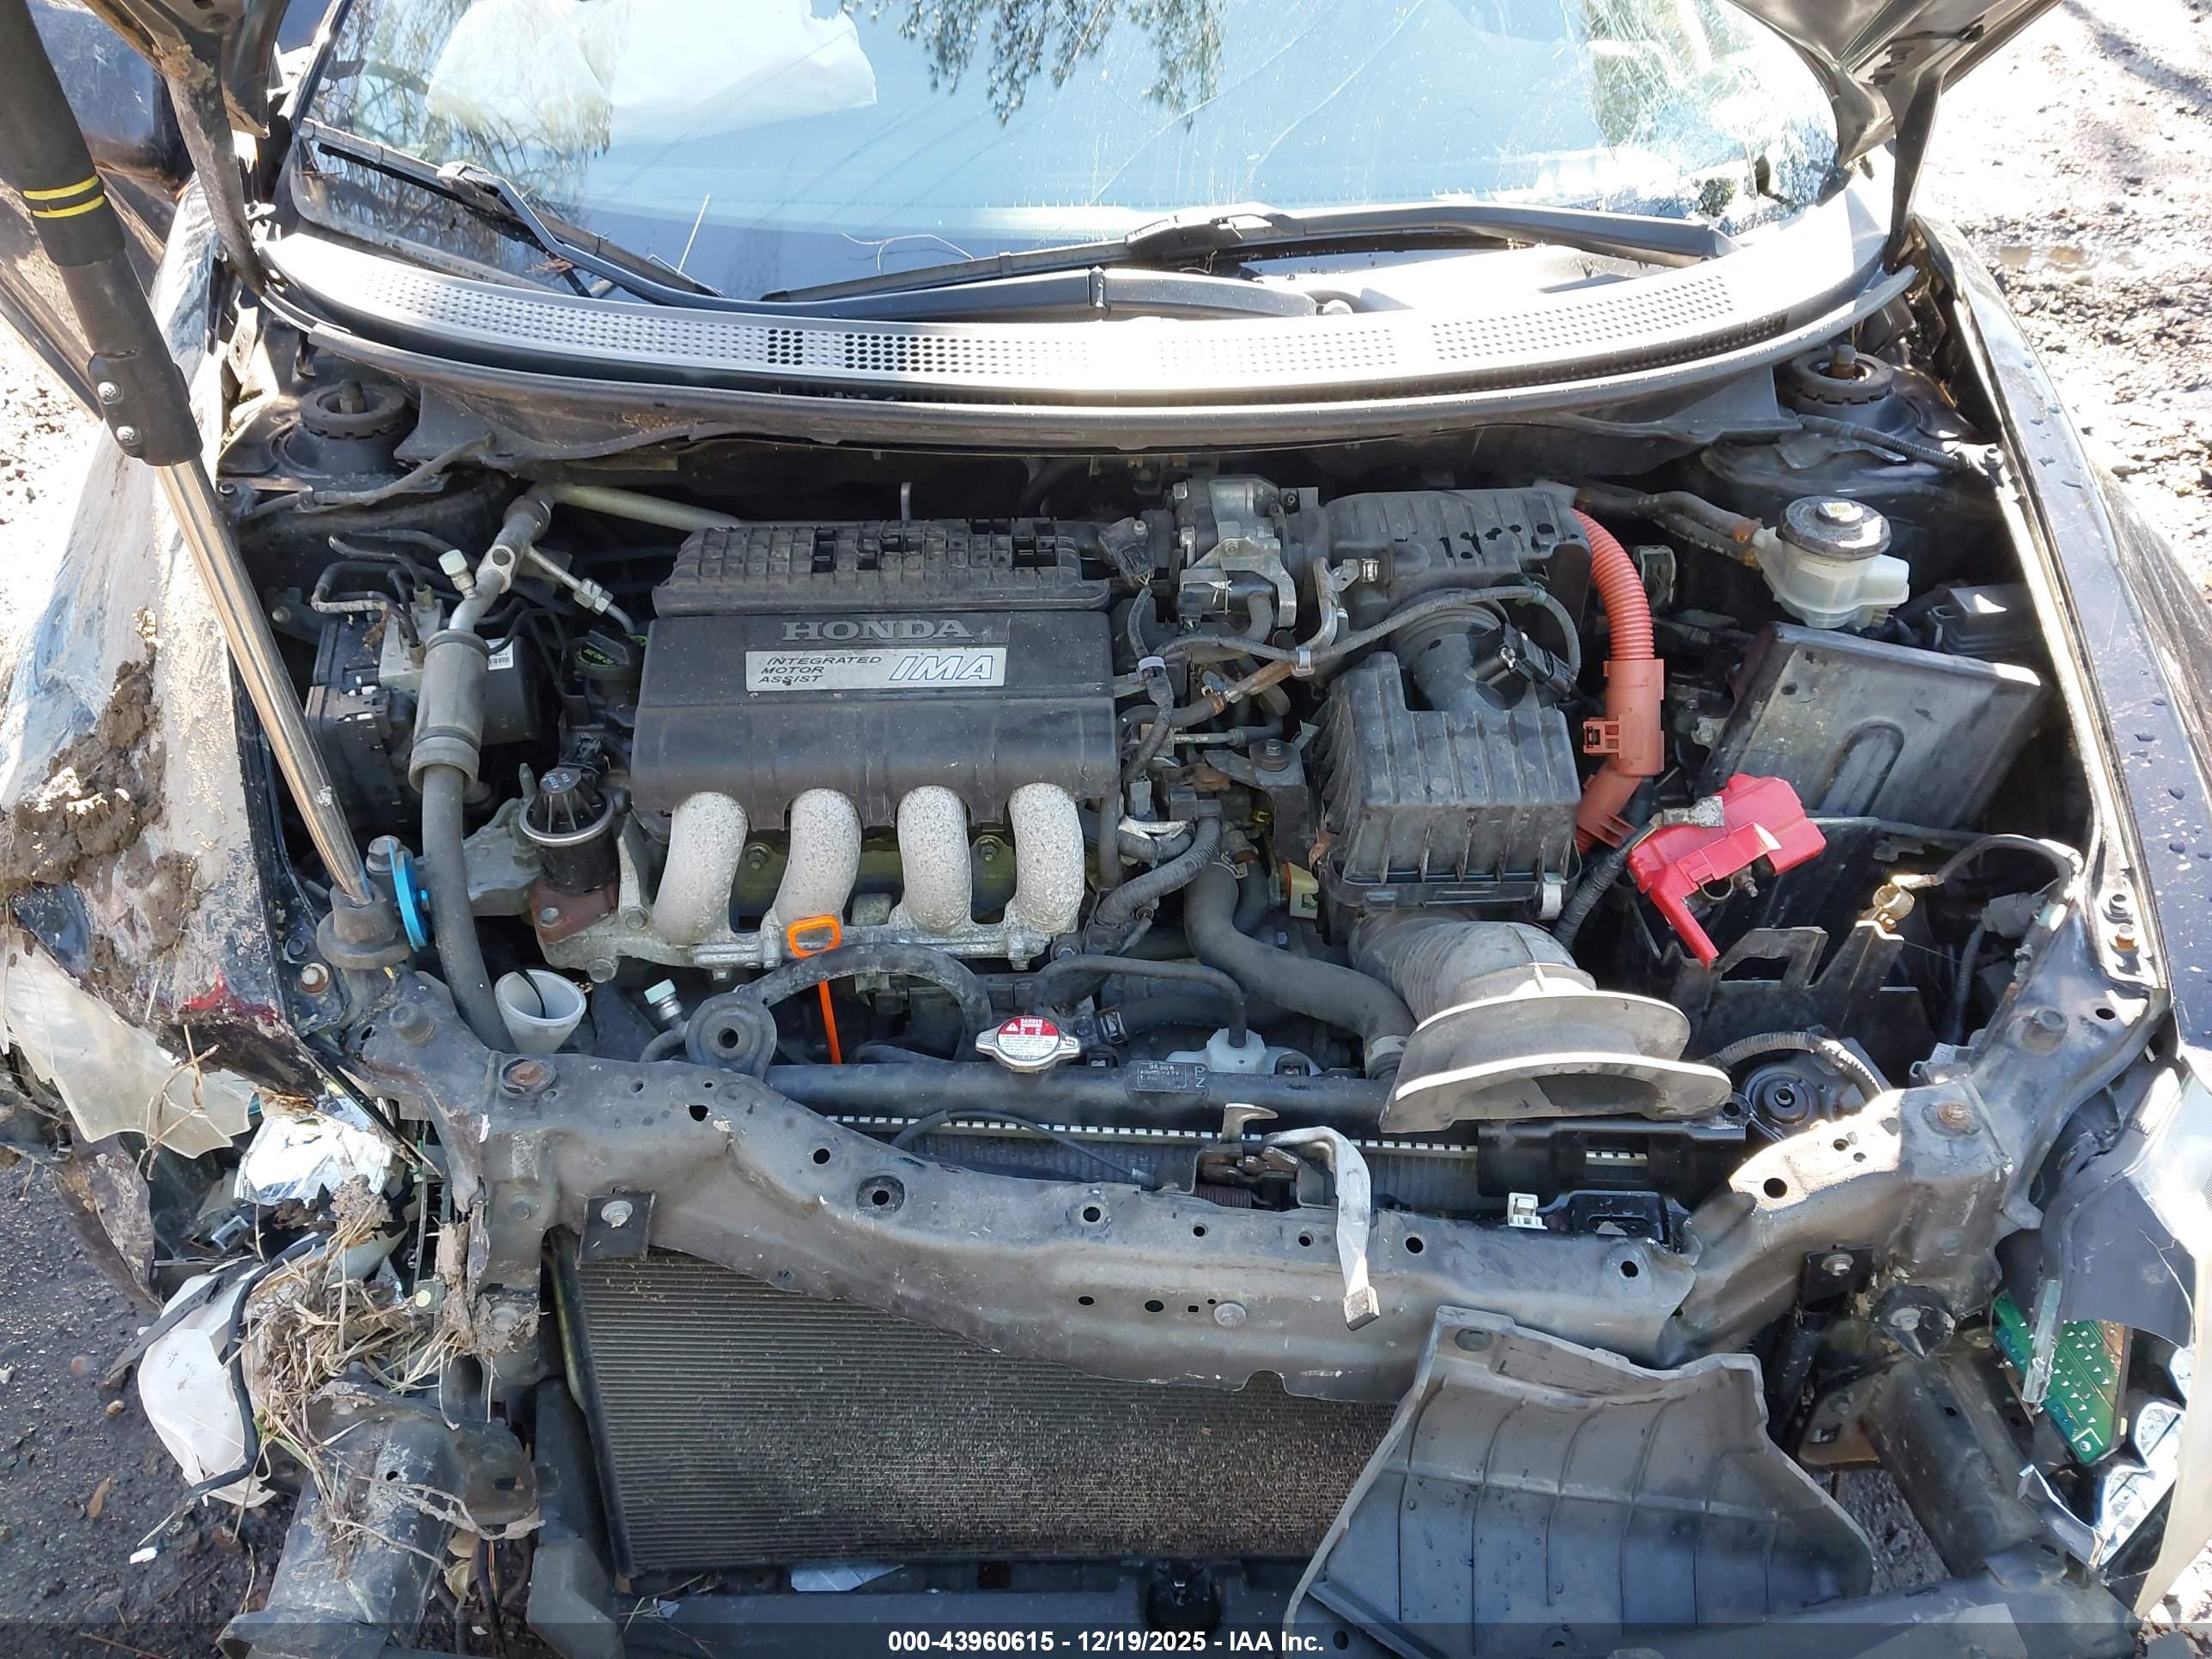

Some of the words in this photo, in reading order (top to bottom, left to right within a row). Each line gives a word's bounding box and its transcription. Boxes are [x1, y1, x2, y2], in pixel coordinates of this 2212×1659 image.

[781, 619, 974, 641] HONDA
[766, 656, 882, 665] INTEGRATED
[888, 654, 994, 681] IMA
[758, 675, 823, 684] ASSIST
